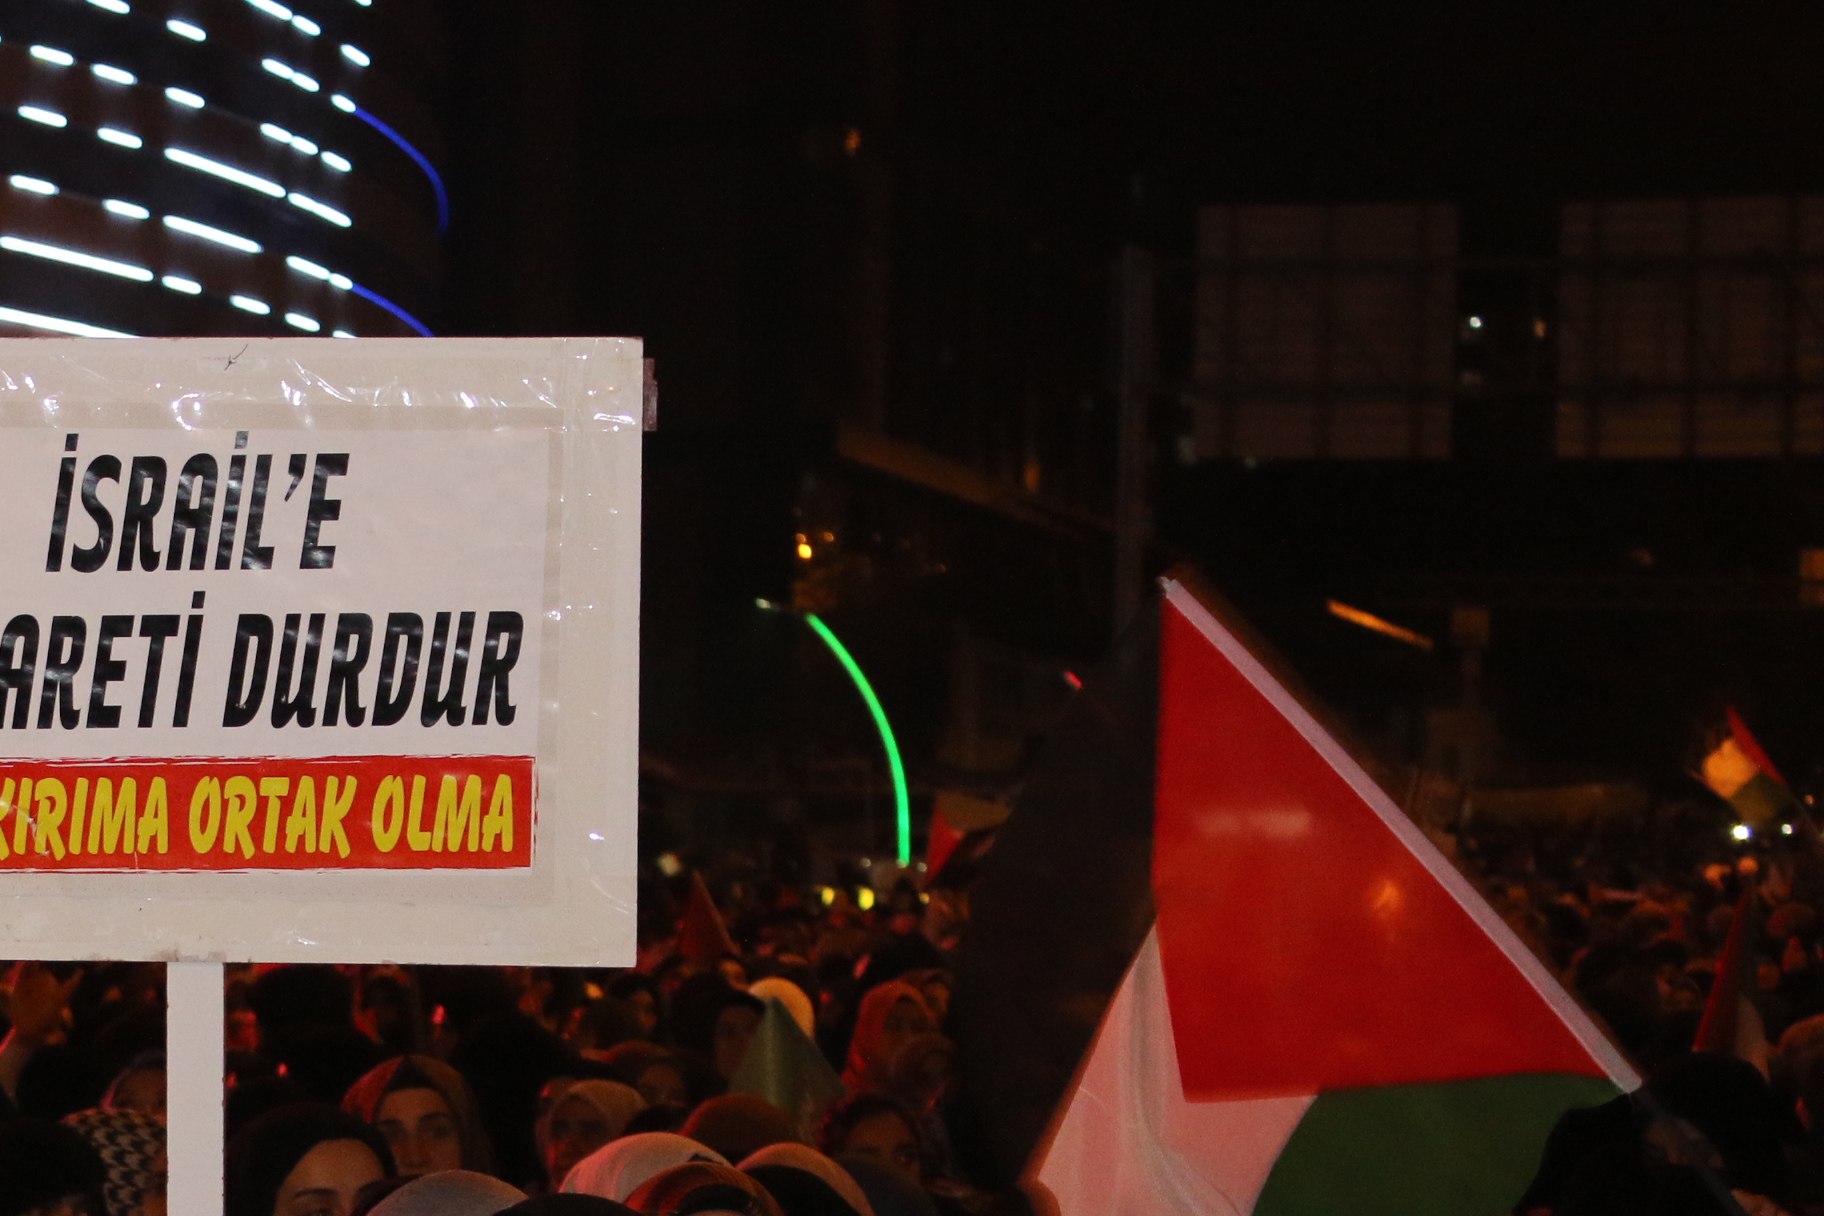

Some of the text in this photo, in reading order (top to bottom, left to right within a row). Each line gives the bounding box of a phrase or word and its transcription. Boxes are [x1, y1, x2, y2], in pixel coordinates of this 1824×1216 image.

[222, 610, 525, 729] DURDUR
[188, 775, 358, 861] ORTAK
[374, 774, 514, 854] OLMA
